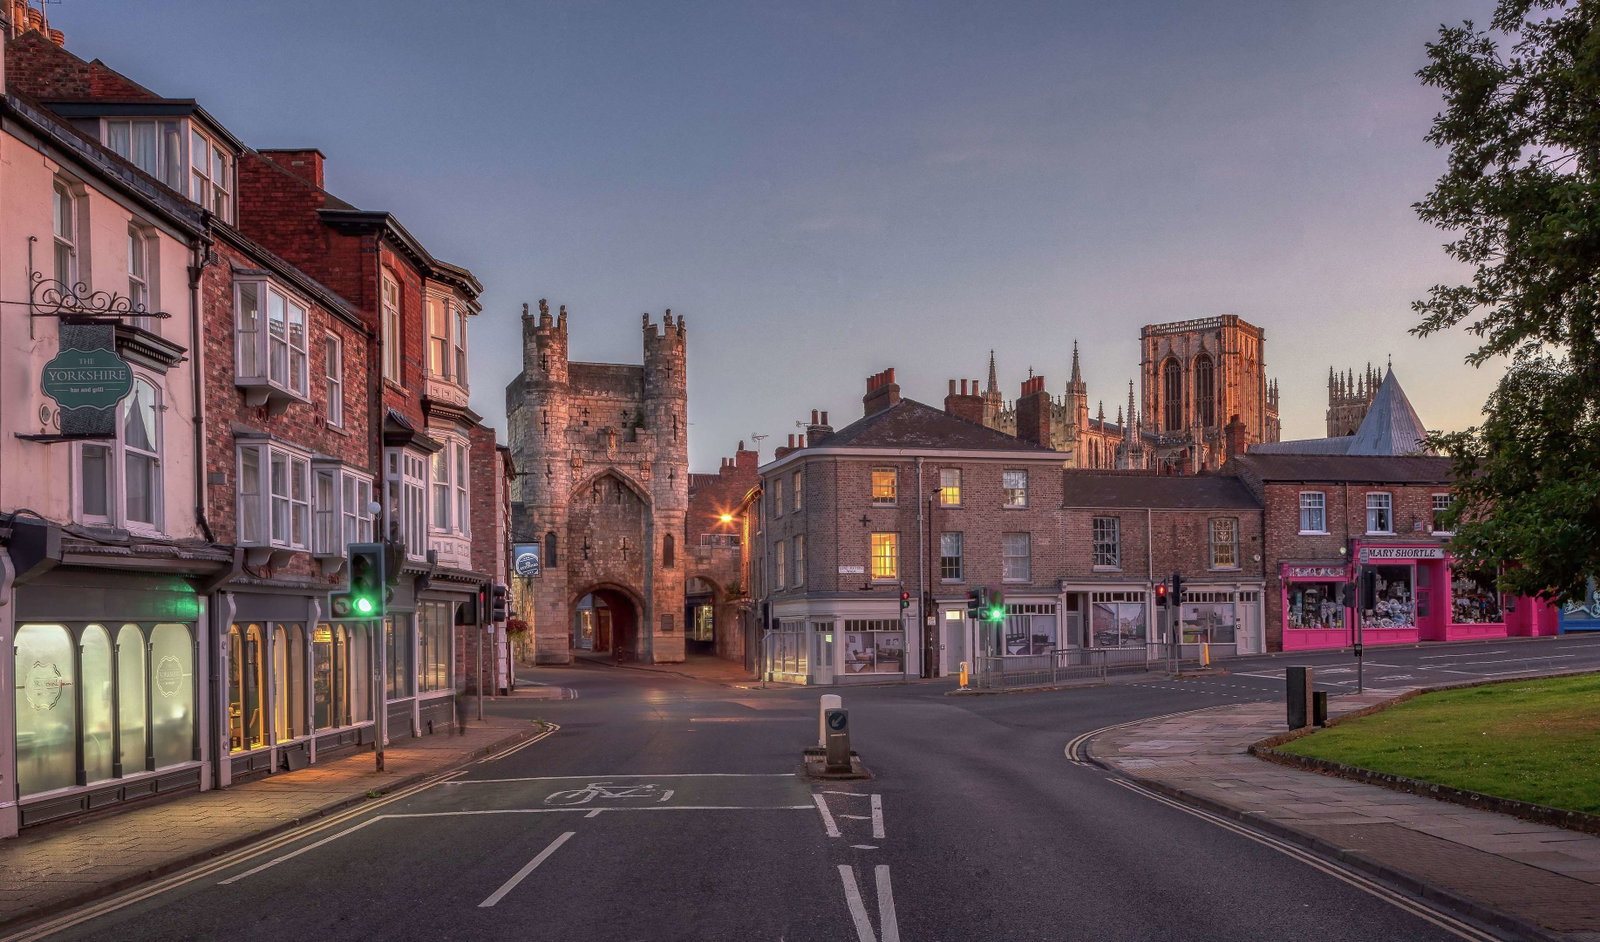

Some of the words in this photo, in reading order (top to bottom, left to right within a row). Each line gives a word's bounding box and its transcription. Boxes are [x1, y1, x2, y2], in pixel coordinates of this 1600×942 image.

[48, 370, 127, 381] YORKSHIRE
[1369, 548, 1394, 558] MARY
[1395, 548, 1436, 558] SHORTLE
